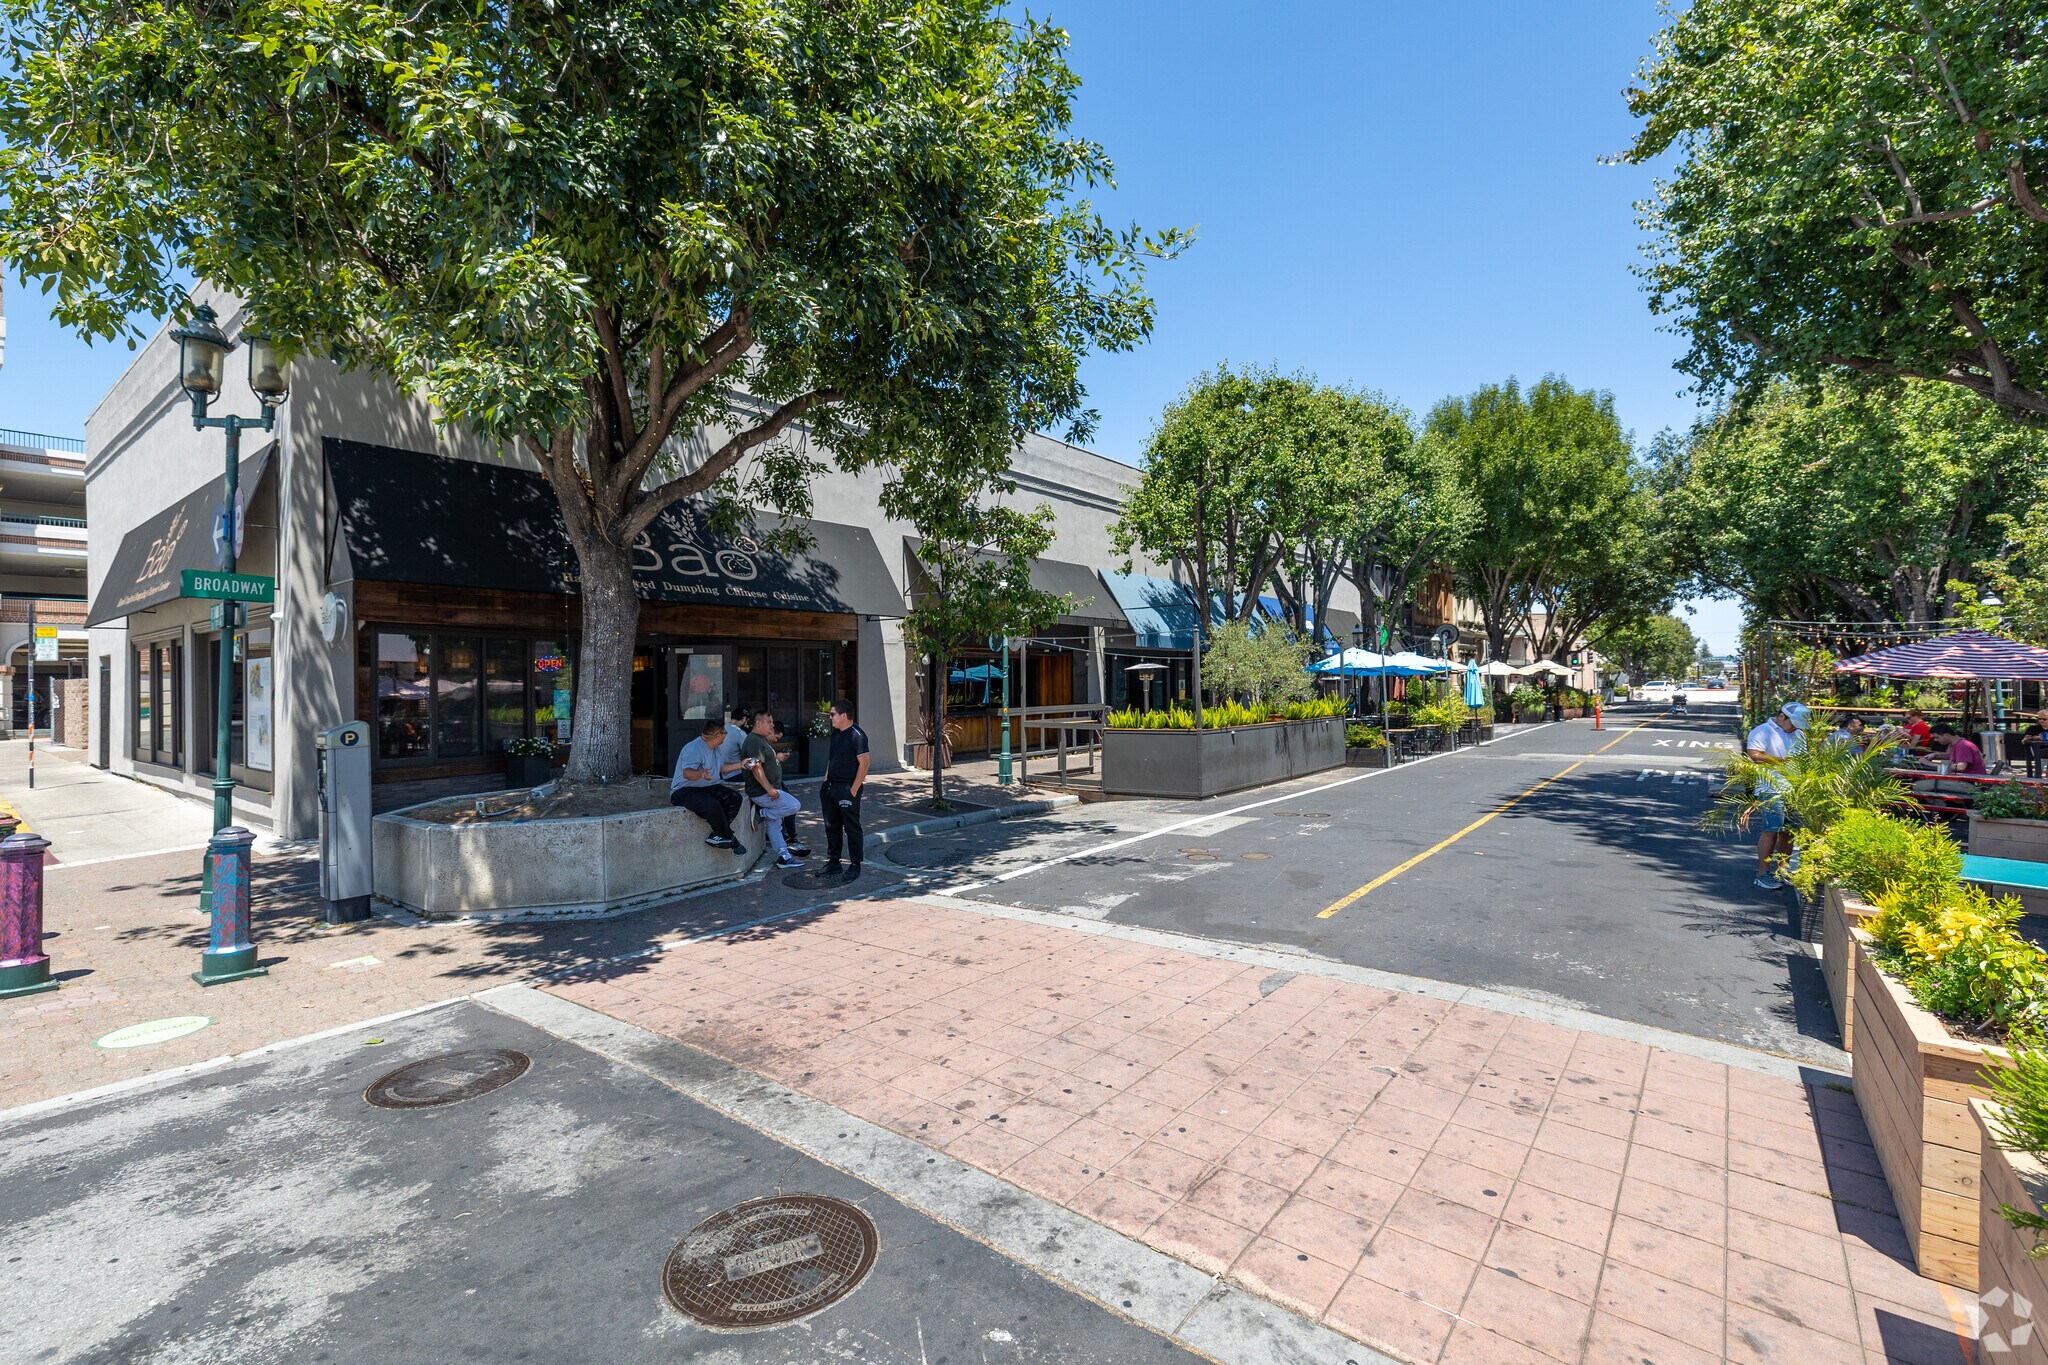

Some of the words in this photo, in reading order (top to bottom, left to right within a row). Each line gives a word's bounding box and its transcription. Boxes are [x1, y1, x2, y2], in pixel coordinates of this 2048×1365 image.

[136, 538, 177, 584] Bao
[194, 577, 266, 595] BROADWAY
[662, 581, 720, 596] Dumpling
[725, 586, 768, 599] Chinese
[772, 590, 810, 602] Cuisine
[537, 659, 563, 669] OPEN
[345, 733, 356, 744] P
[1652, 739, 1734, 749] XING
[735, 1237, 810, 1267] SANITARY
[747, 1251, 805, 1273] SEWER
[736, 1303, 782, 1311] OAKLAND
